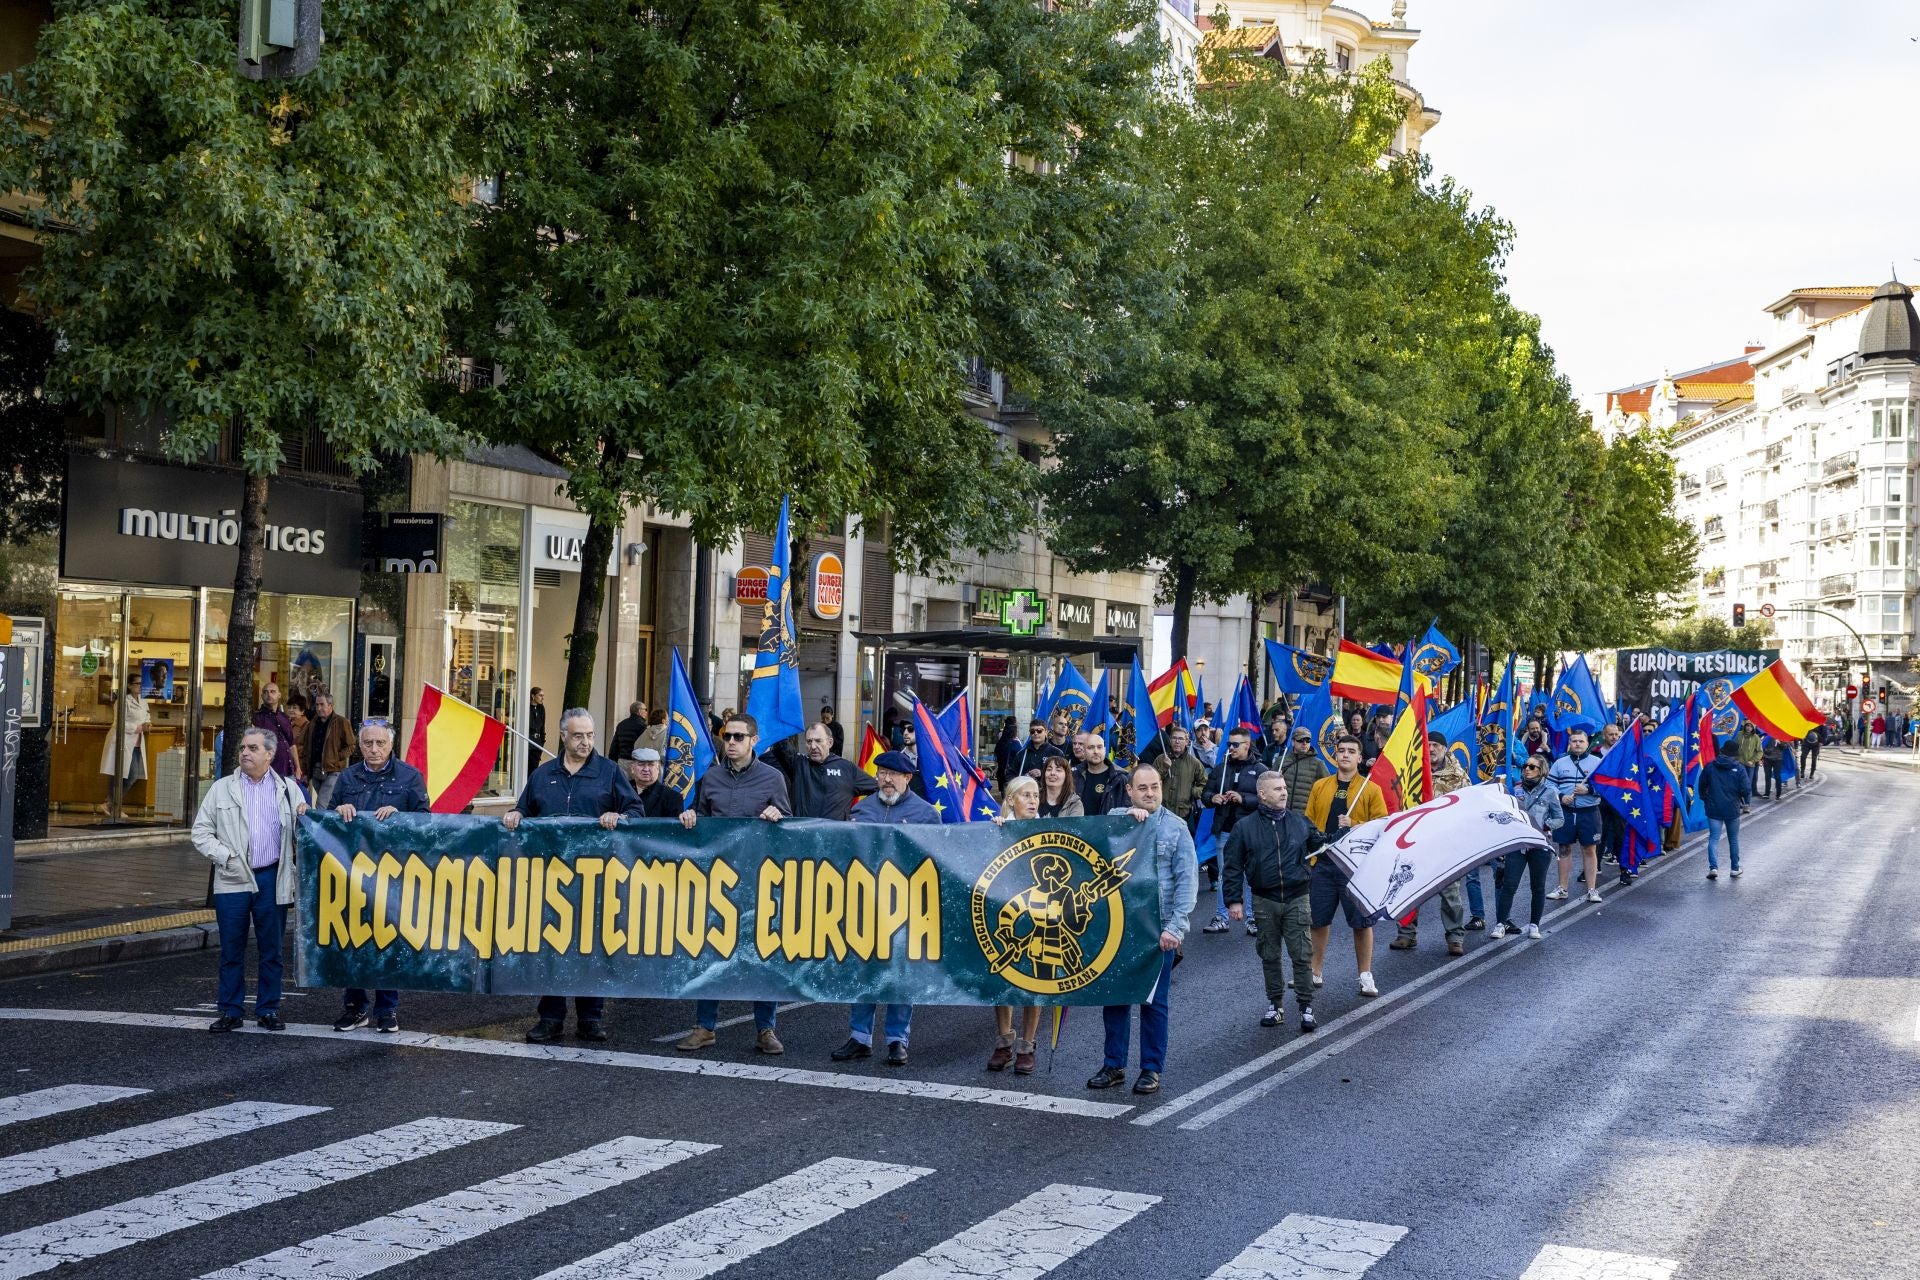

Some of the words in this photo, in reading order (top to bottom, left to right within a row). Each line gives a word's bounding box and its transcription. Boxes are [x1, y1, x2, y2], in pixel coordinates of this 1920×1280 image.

[737, 578, 768, 587] BURGER
[818, 573, 842, 587] BURGER
[736, 586, 768, 598] KING
[817, 586, 842, 605] KING
[1059, 602, 1092, 624] KRACK
[1107, 608, 1137, 629] KRACK
[1630, 652, 1687, 673] EUROPA
[826, 768, 842, 777] HH
[1040, 834, 1086, 853] ALFONSO
[1085, 848, 1093, 858] I
[983, 838, 1035, 881] CULTURAL
[318, 850, 740, 960] RECONQUISTEMOS
[755, 856, 942, 963] EUROPA
[973, 884, 995, 955] ASOCIACION
